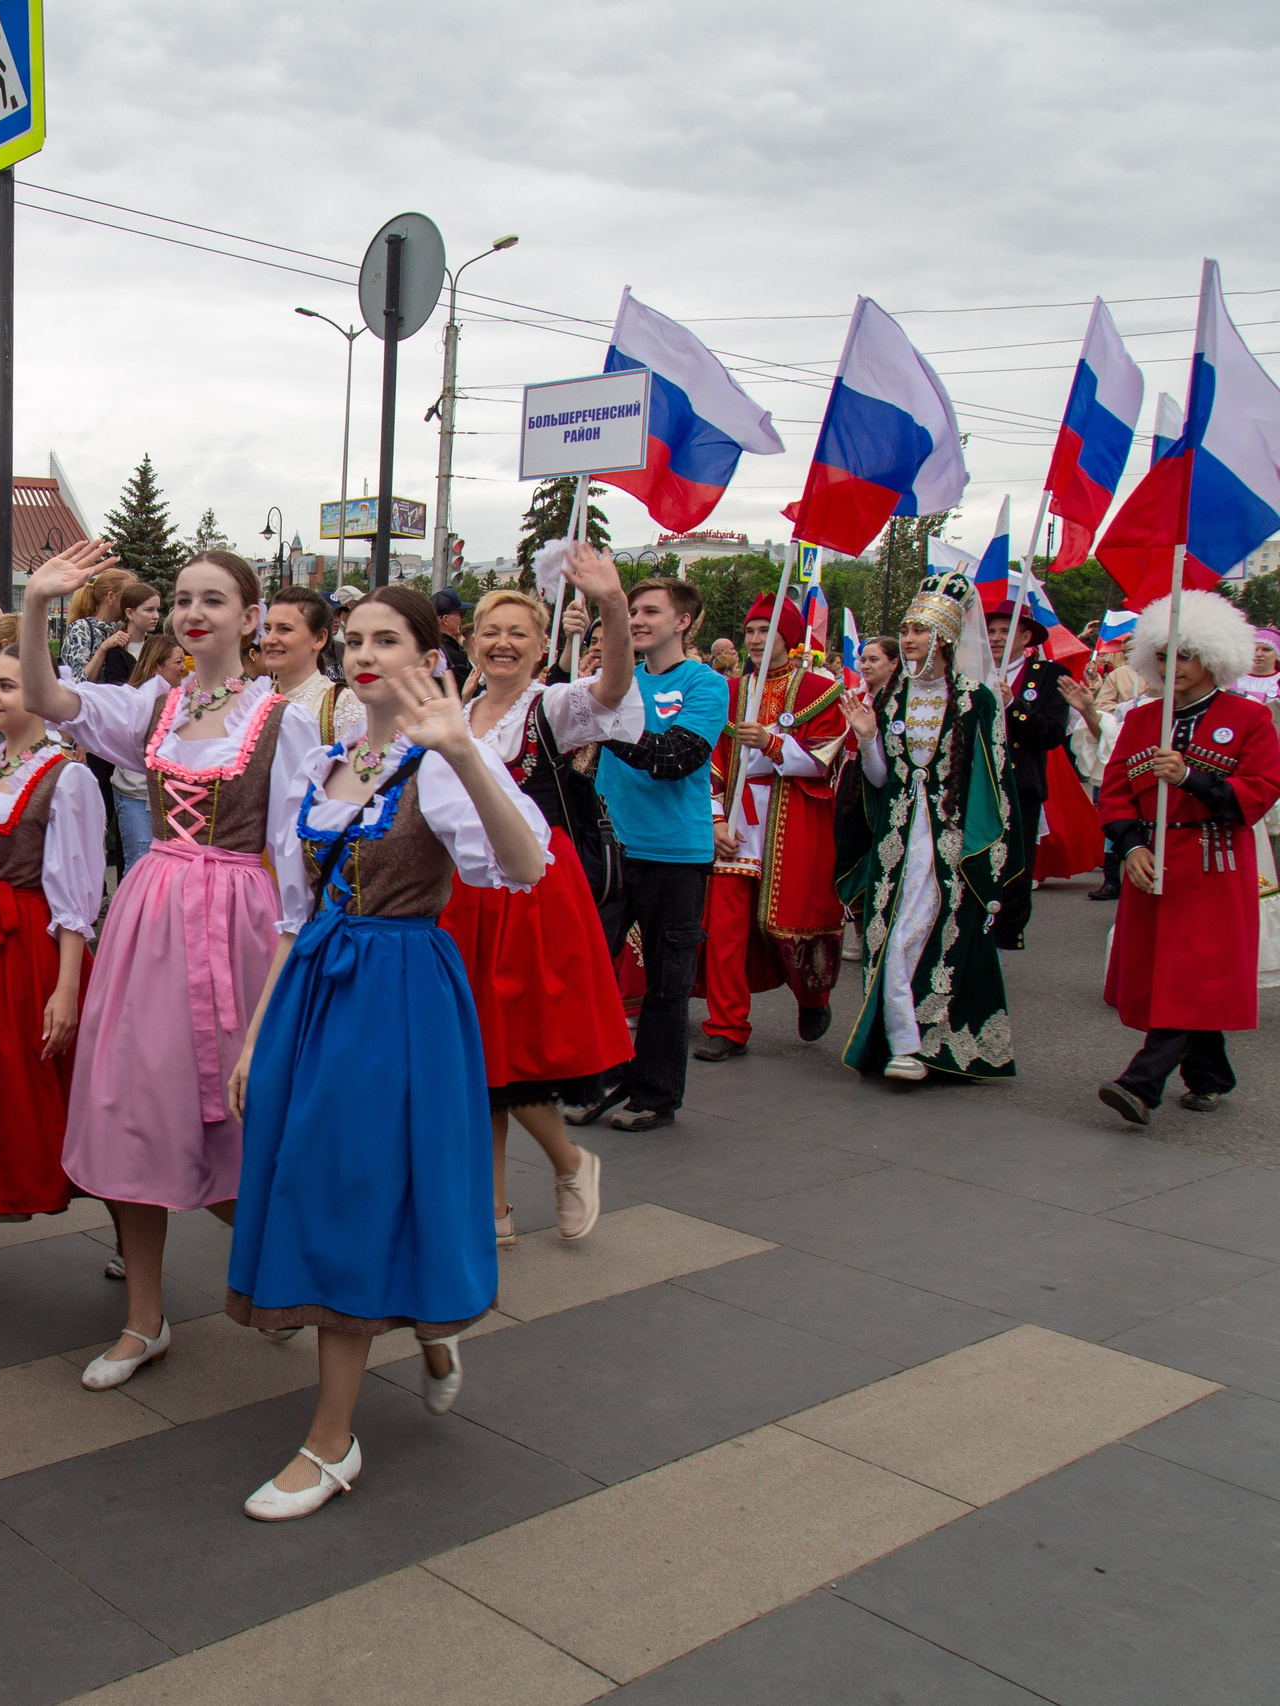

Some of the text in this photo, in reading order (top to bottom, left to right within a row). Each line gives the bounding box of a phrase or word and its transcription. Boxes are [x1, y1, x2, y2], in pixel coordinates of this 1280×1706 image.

[528, 400, 641, 429] БОЛЬШЕРЕЧЕНСКИЙ
[563, 426, 601, 443] РАЙОН
[701, 529, 747, 540] alfabank.ru
